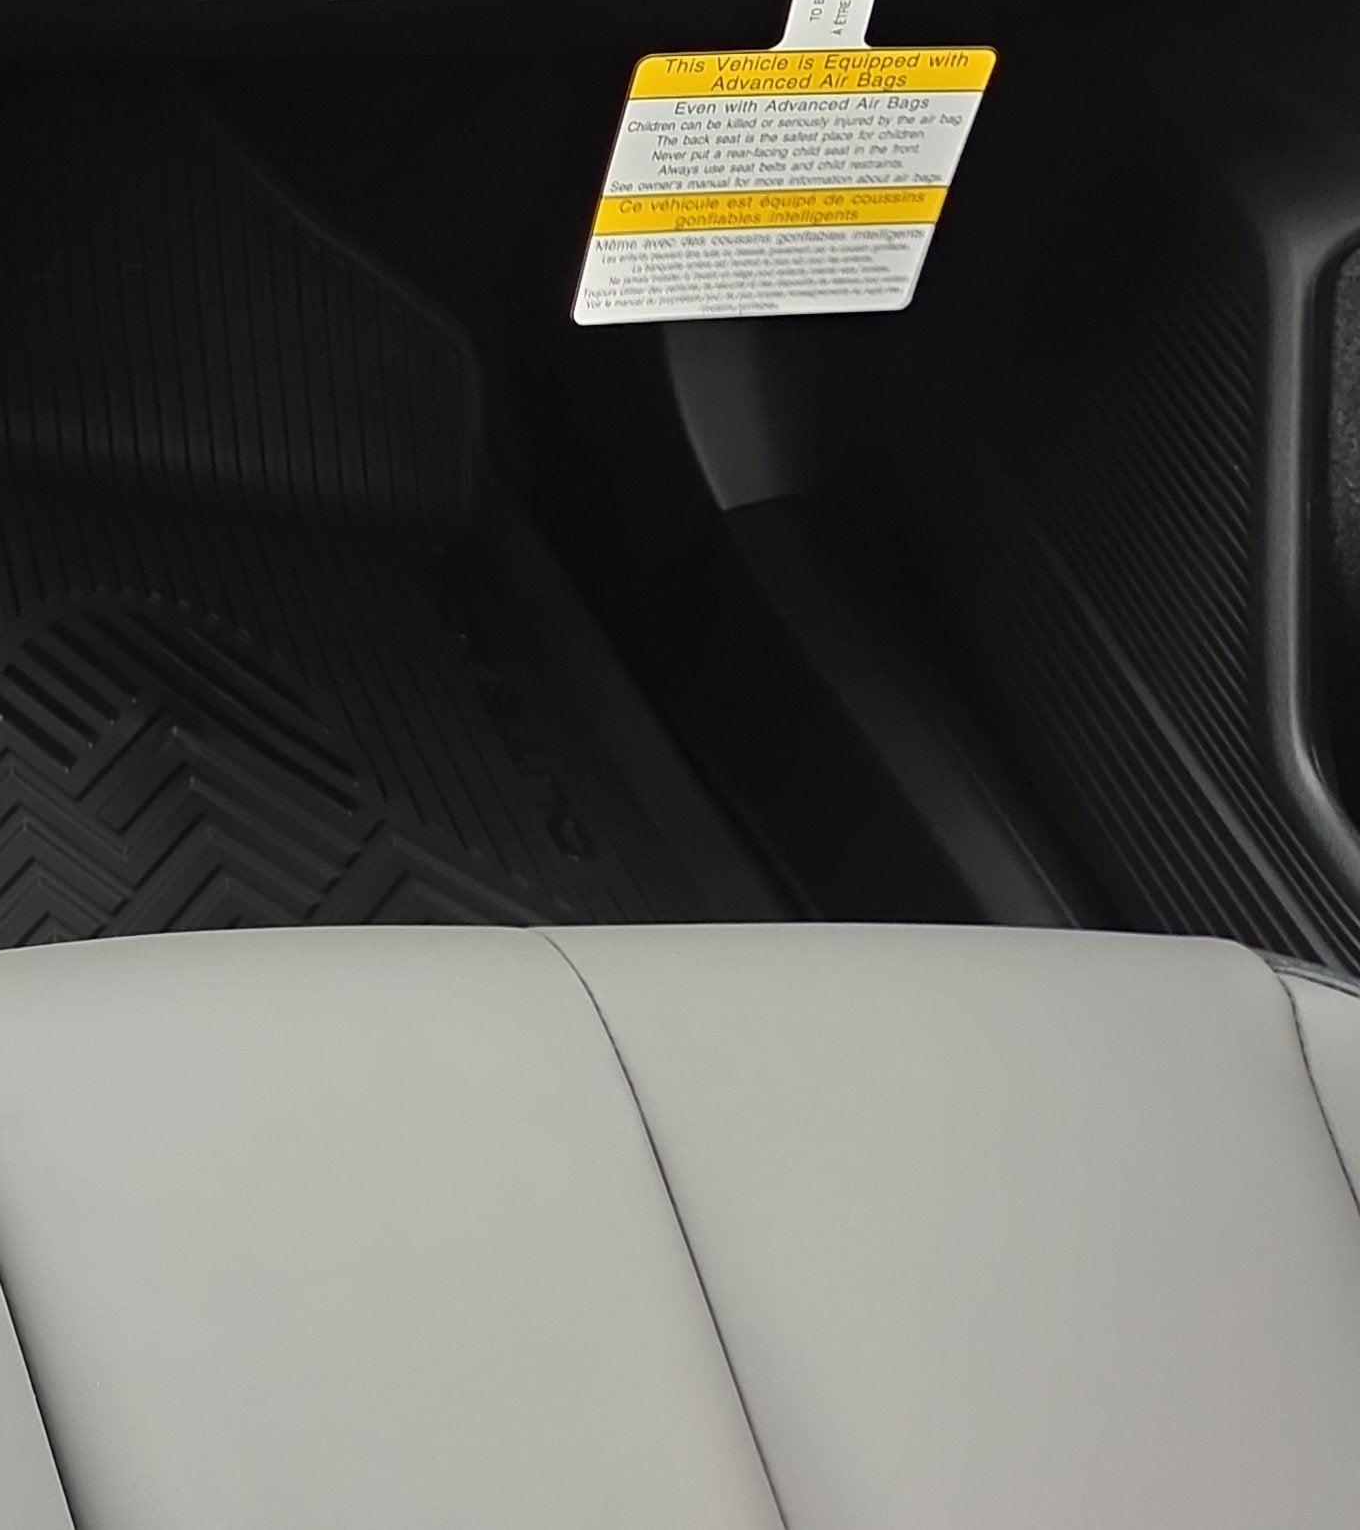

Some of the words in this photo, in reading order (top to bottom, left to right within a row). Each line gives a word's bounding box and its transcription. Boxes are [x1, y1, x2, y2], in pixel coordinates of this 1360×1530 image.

[810, 7, 823, 21] TO
[665, 59, 705, 74] This
[717, 56, 789, 73] Vehicle
[797, 55, 813, 70] is
[823, 53, 920, 74] Equipped
[929, 53, 969, 69] with
[710, 74, 812, 92] Advanced
[819, 73, 848, 89] Air
[857, 72, 907, 92] Bags
[674, 101, 716, 116] Even
[724, 98, 757, 114] with
[765, 96, 849, 114] Advanced
[856, 96, 880, 111] Air
[886, 96, 930, 113] Bags
[627, 120, 676, 132] Children
[680, 121, 702, 131] can
[706, 119, 722, 130] be
[761, 119, 774, 128] or
[657, 135, 679, 146] The
[682, 134, 709, 146] back
[715, 134, 741, 145] seat
[745, 133, 755, 144] is
[759, 132, 779, 143] the
[651, 150, 687, 161] Never
[690, 149, 710, 162] put
[713, 150, 722, 160] a
[658, 165, 699, 177] Always
[704, 165, 726, 174] use
[618, 199, 643, 214] Ce
[727, 196, 753, 210] est
